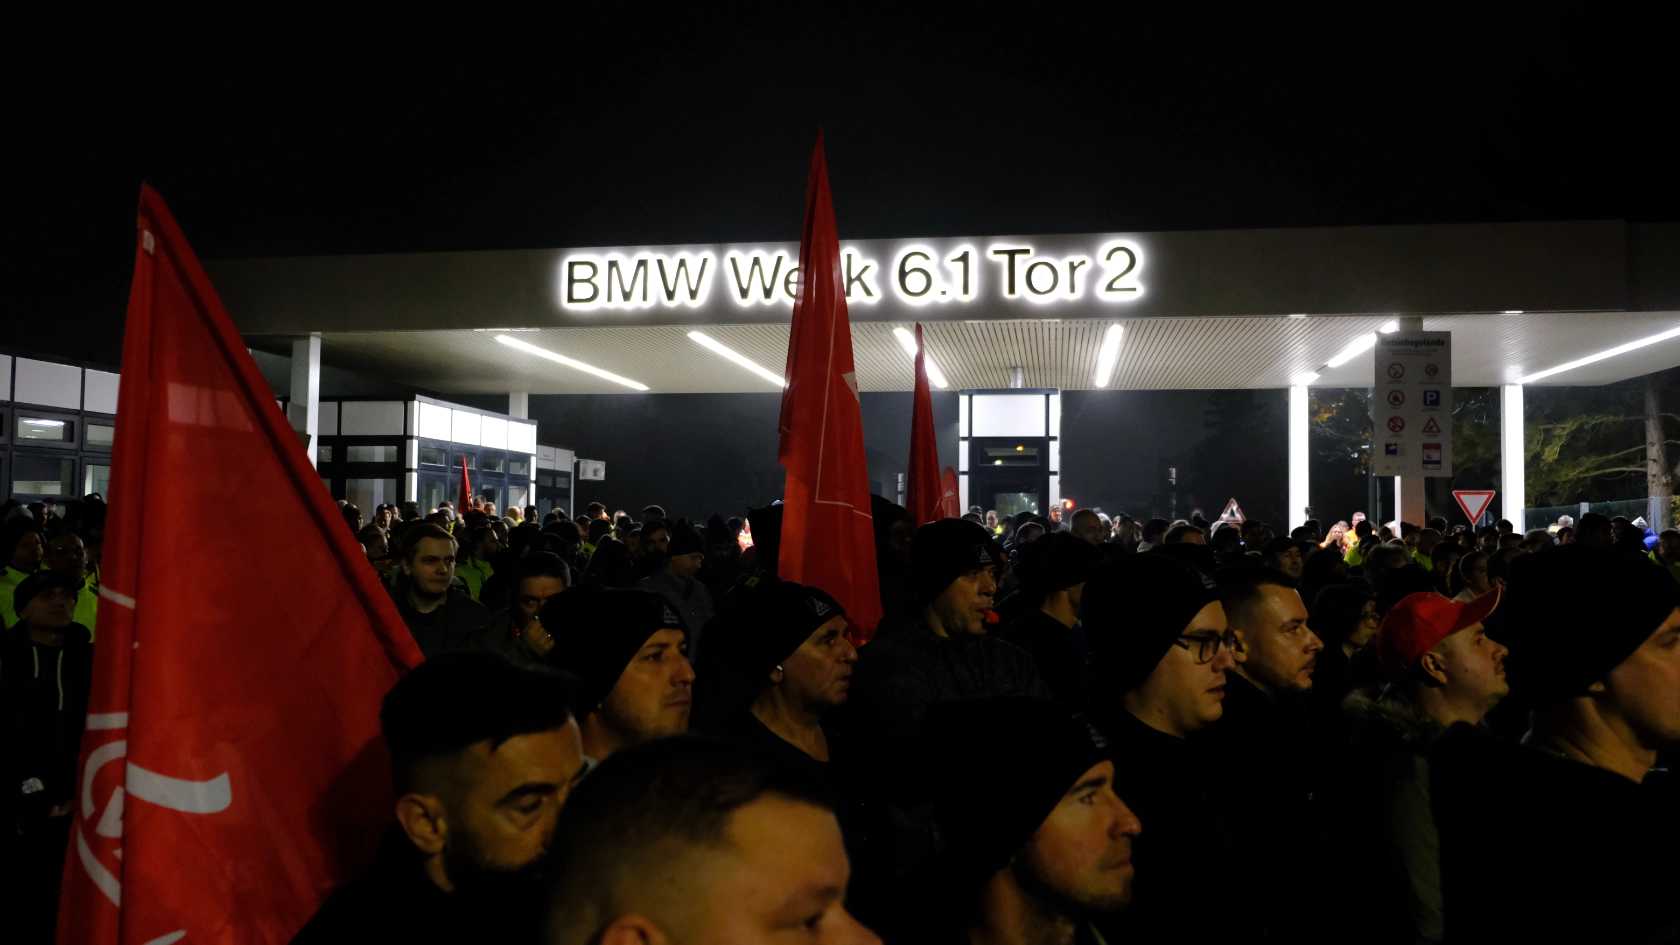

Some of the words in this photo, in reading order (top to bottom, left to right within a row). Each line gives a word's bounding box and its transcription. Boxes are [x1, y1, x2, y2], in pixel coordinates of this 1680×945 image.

[567, 257, 708, 303] BMW
[730, 254, 873, 301] Wek
[898, 251, 970, 297] 6.1
[993, 248, 1086, 295] Tor
[1104, 246, 1137, 292] 2
[1381, 338, 1445, 347] Betriebsgelände
